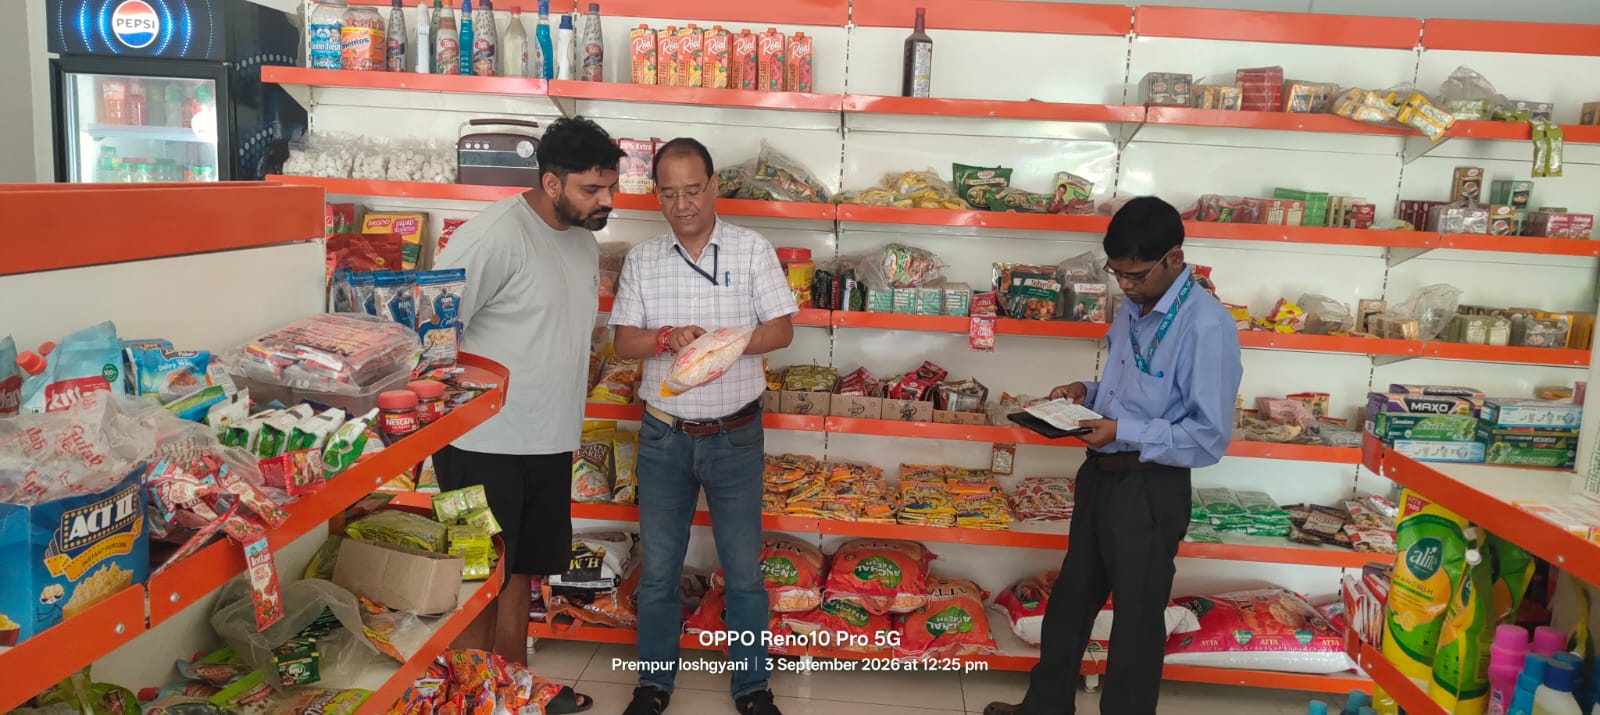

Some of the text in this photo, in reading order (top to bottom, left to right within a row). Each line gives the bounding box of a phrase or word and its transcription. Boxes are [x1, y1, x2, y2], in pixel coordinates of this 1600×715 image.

[116, 18, 155, 29] PEPSI
[342, 37, 370, 49] mentos
[633, 34, 653, 54] Real
[1411, 402, 1448, 413] MAXO
[68, 504, 113, 541] ACT
